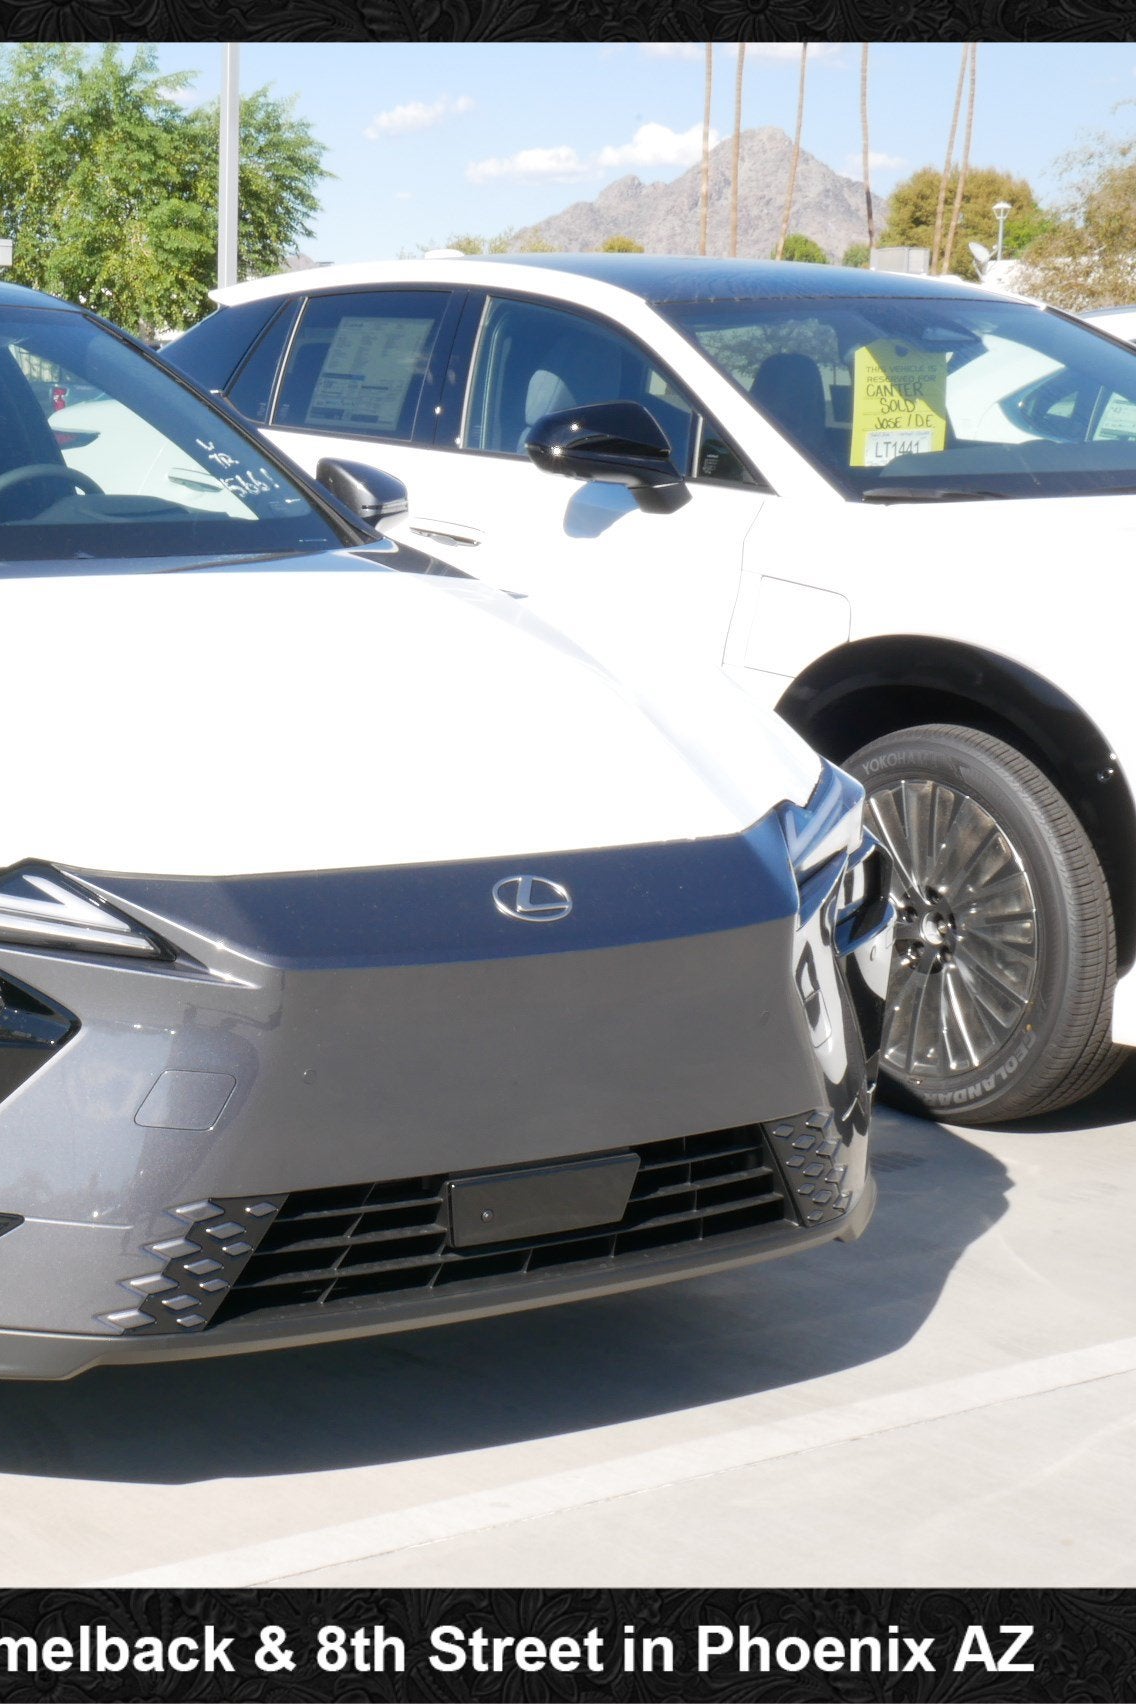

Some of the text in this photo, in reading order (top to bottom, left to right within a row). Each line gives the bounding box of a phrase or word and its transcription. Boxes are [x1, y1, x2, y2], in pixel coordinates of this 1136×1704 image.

[866, 375, 915, 383] RESERVED
[865, 382, 923, 398] CANTER
[879, 397, 916, 415] SOLD
[874, 416, 903, 430] JOSE
[875, 441, 920, 458] LT1441
[862, 752, 933, 776] YOKOHA
